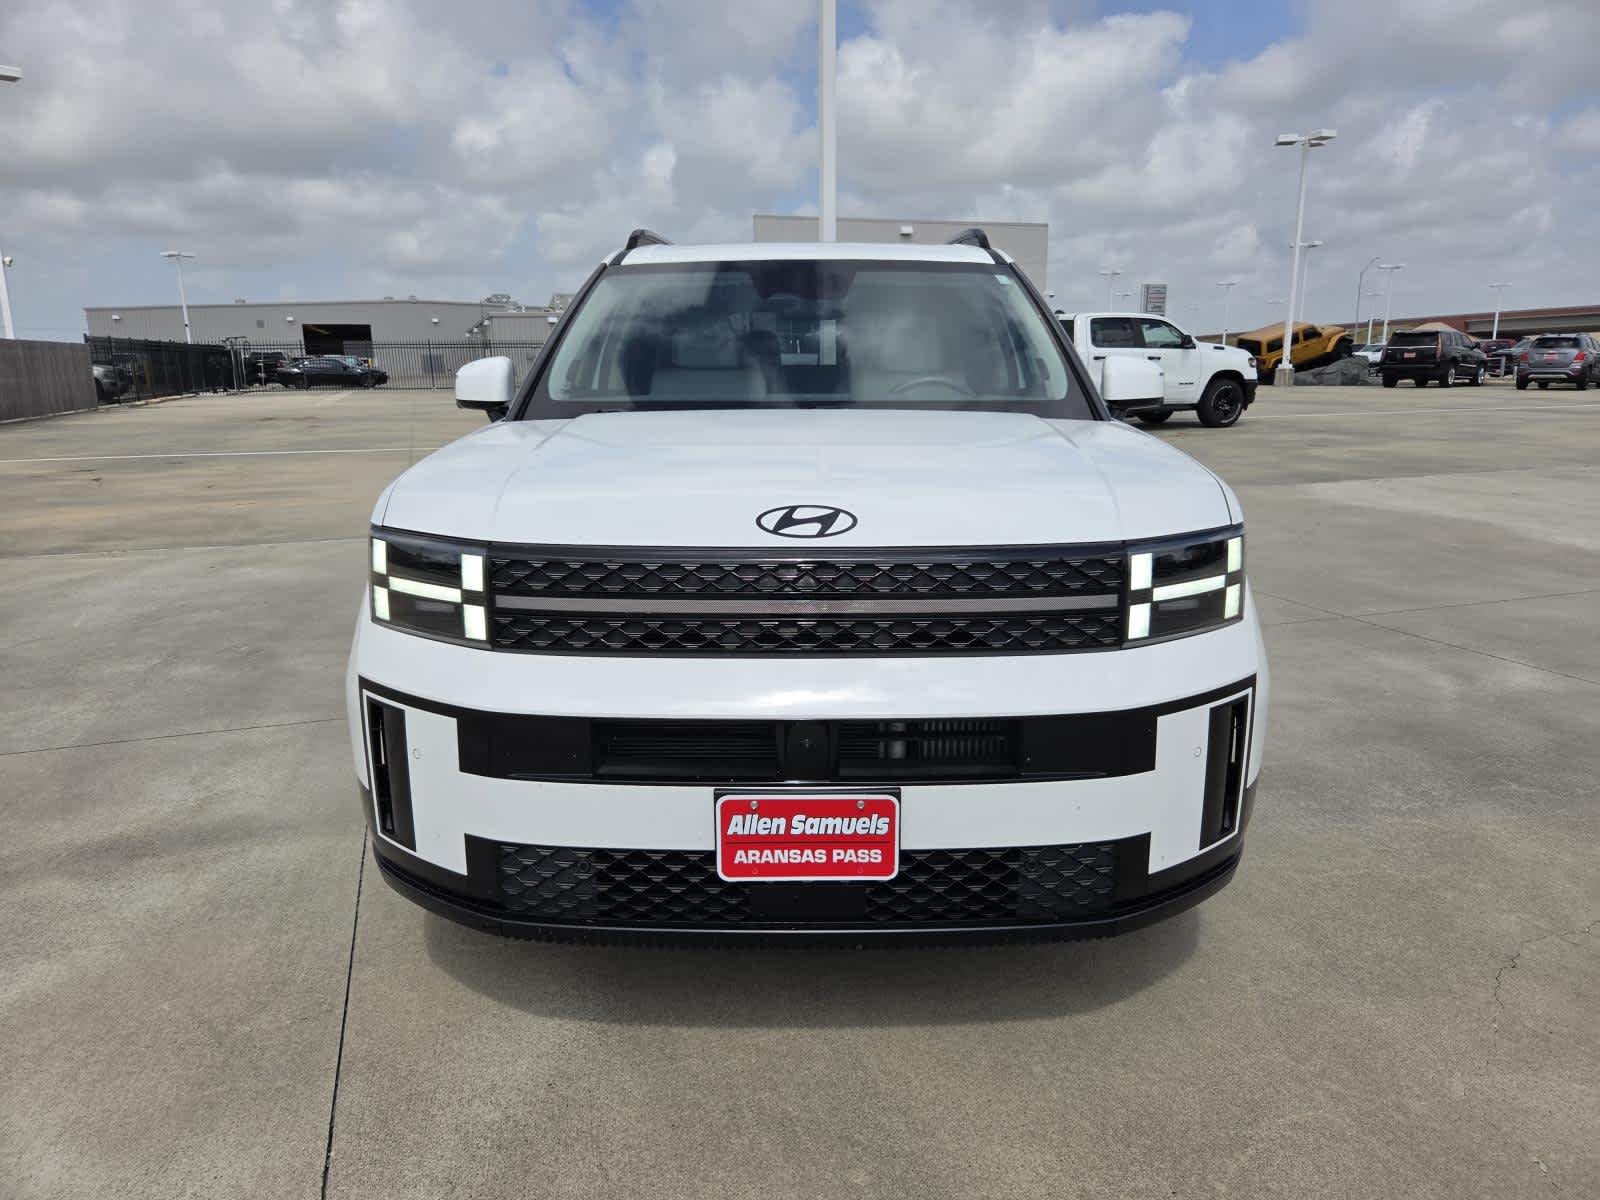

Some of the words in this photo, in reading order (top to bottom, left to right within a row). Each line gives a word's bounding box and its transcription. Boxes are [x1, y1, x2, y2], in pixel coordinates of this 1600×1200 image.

[727, 814, 786, 835] Allen
[790, 814, 890, 836] Samuels
[734, 849, 827, 864] ARANSAS
[832, 849, 882, 863] PASS
